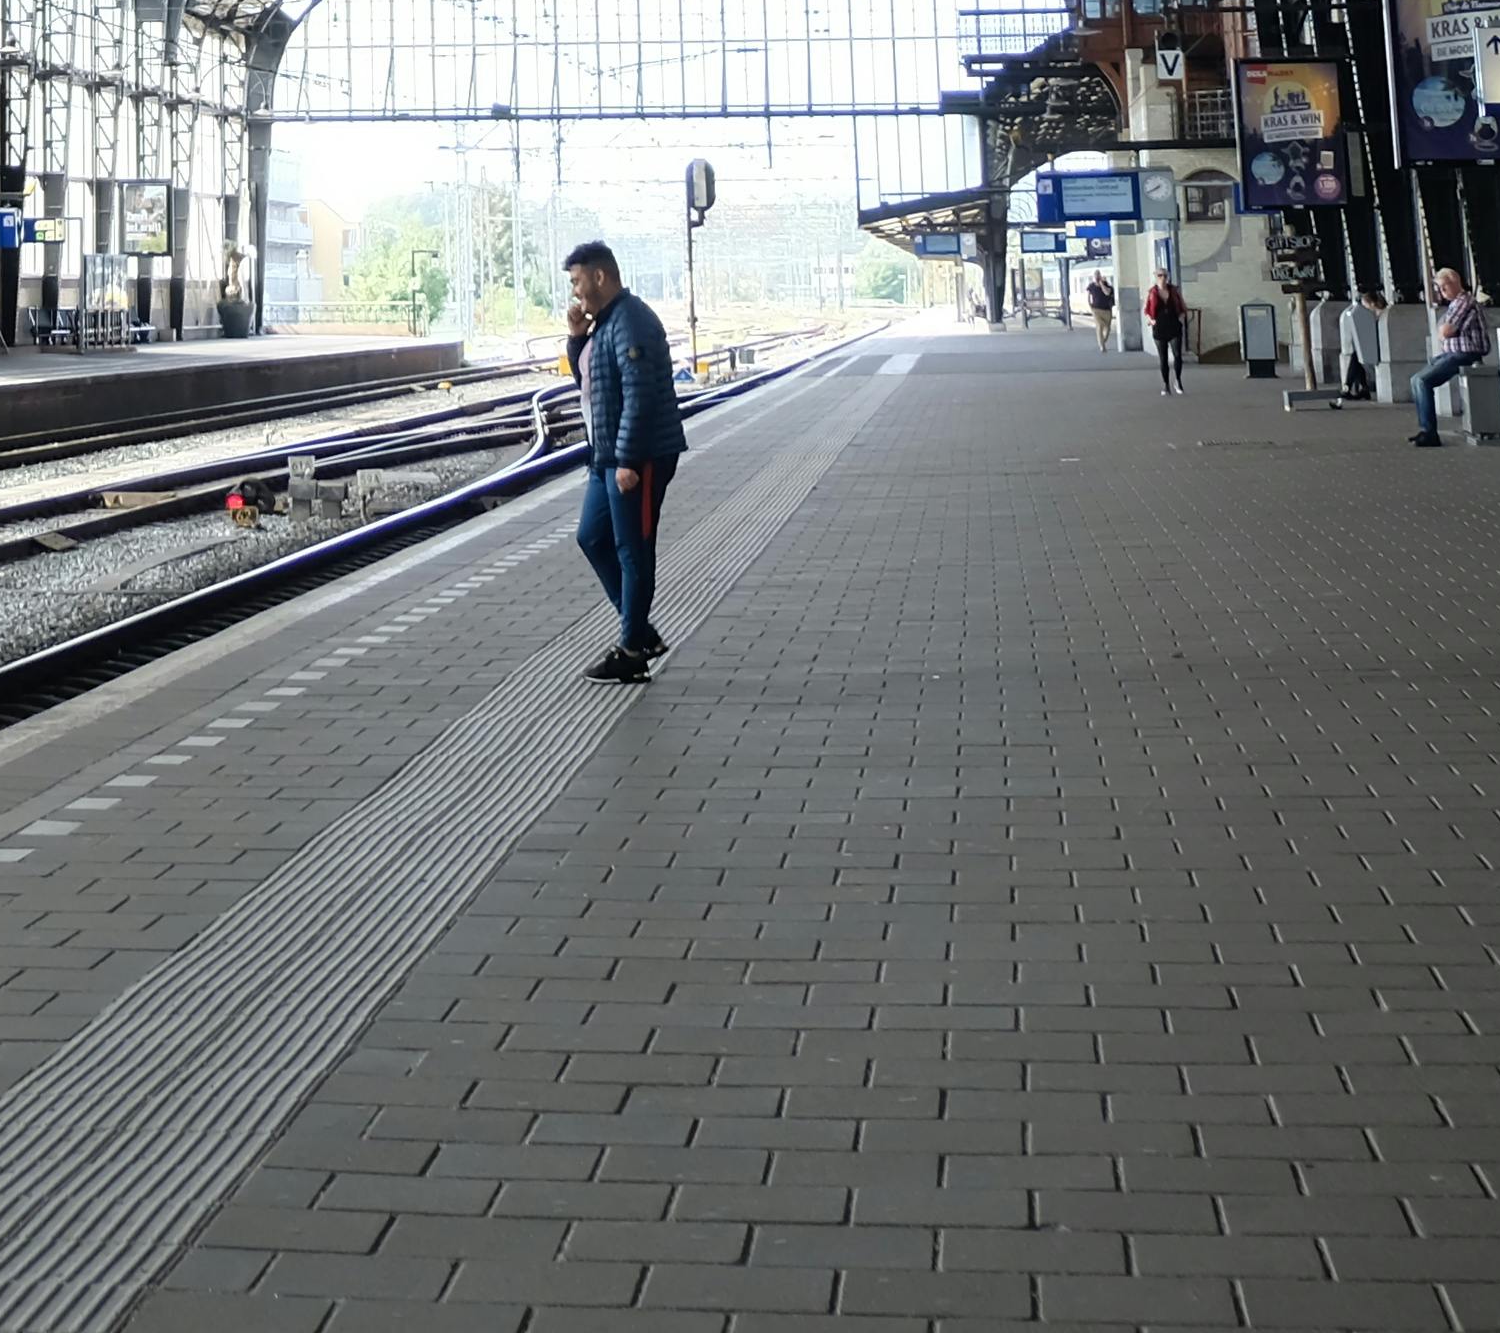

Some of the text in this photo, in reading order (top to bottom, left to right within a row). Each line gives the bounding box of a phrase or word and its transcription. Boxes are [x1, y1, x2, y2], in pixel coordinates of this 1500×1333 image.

[1431, 18, 1469, 39] KRAS
[1159, 53, 1180, 76] V
[1263, 113, 1321, 129] KRAS & WIN
